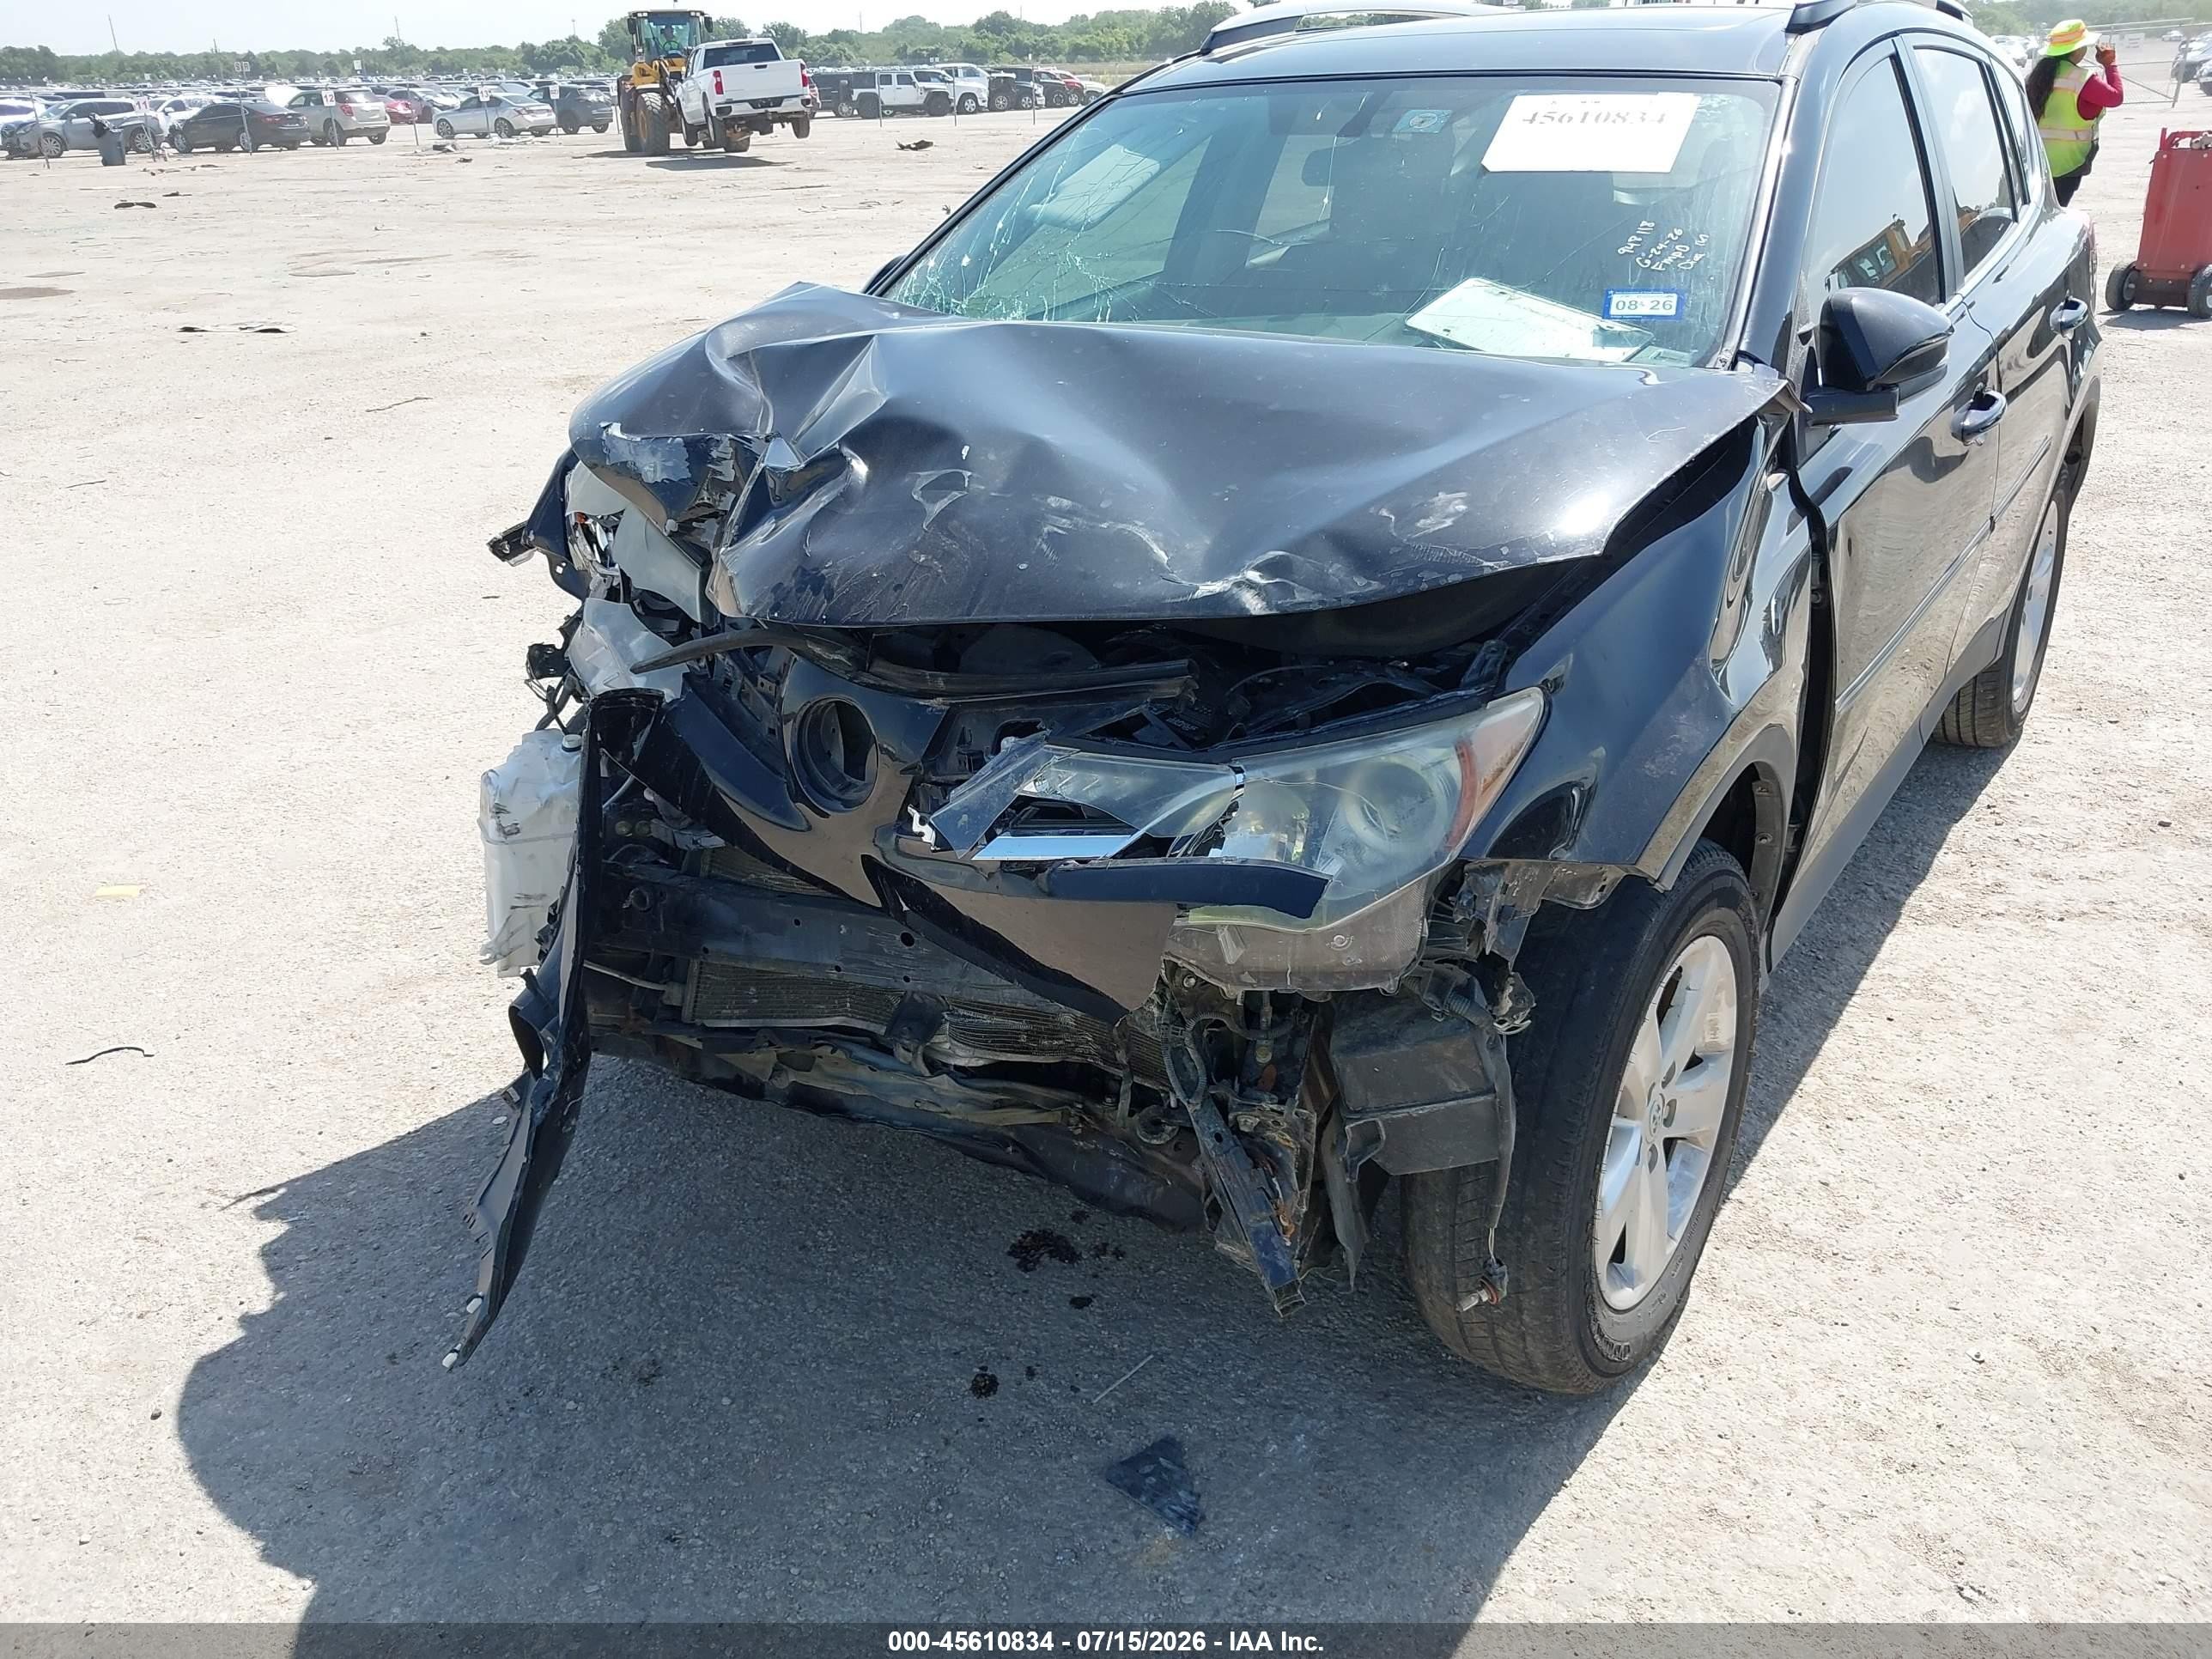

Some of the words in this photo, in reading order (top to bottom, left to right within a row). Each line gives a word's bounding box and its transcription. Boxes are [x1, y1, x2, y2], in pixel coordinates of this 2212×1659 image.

[324, 94, 334, 103] 12
[136, 100, 148, 110] 11
[1615, 300, 1638, 311] 08
[1649, 300, 1673, 311] 26
